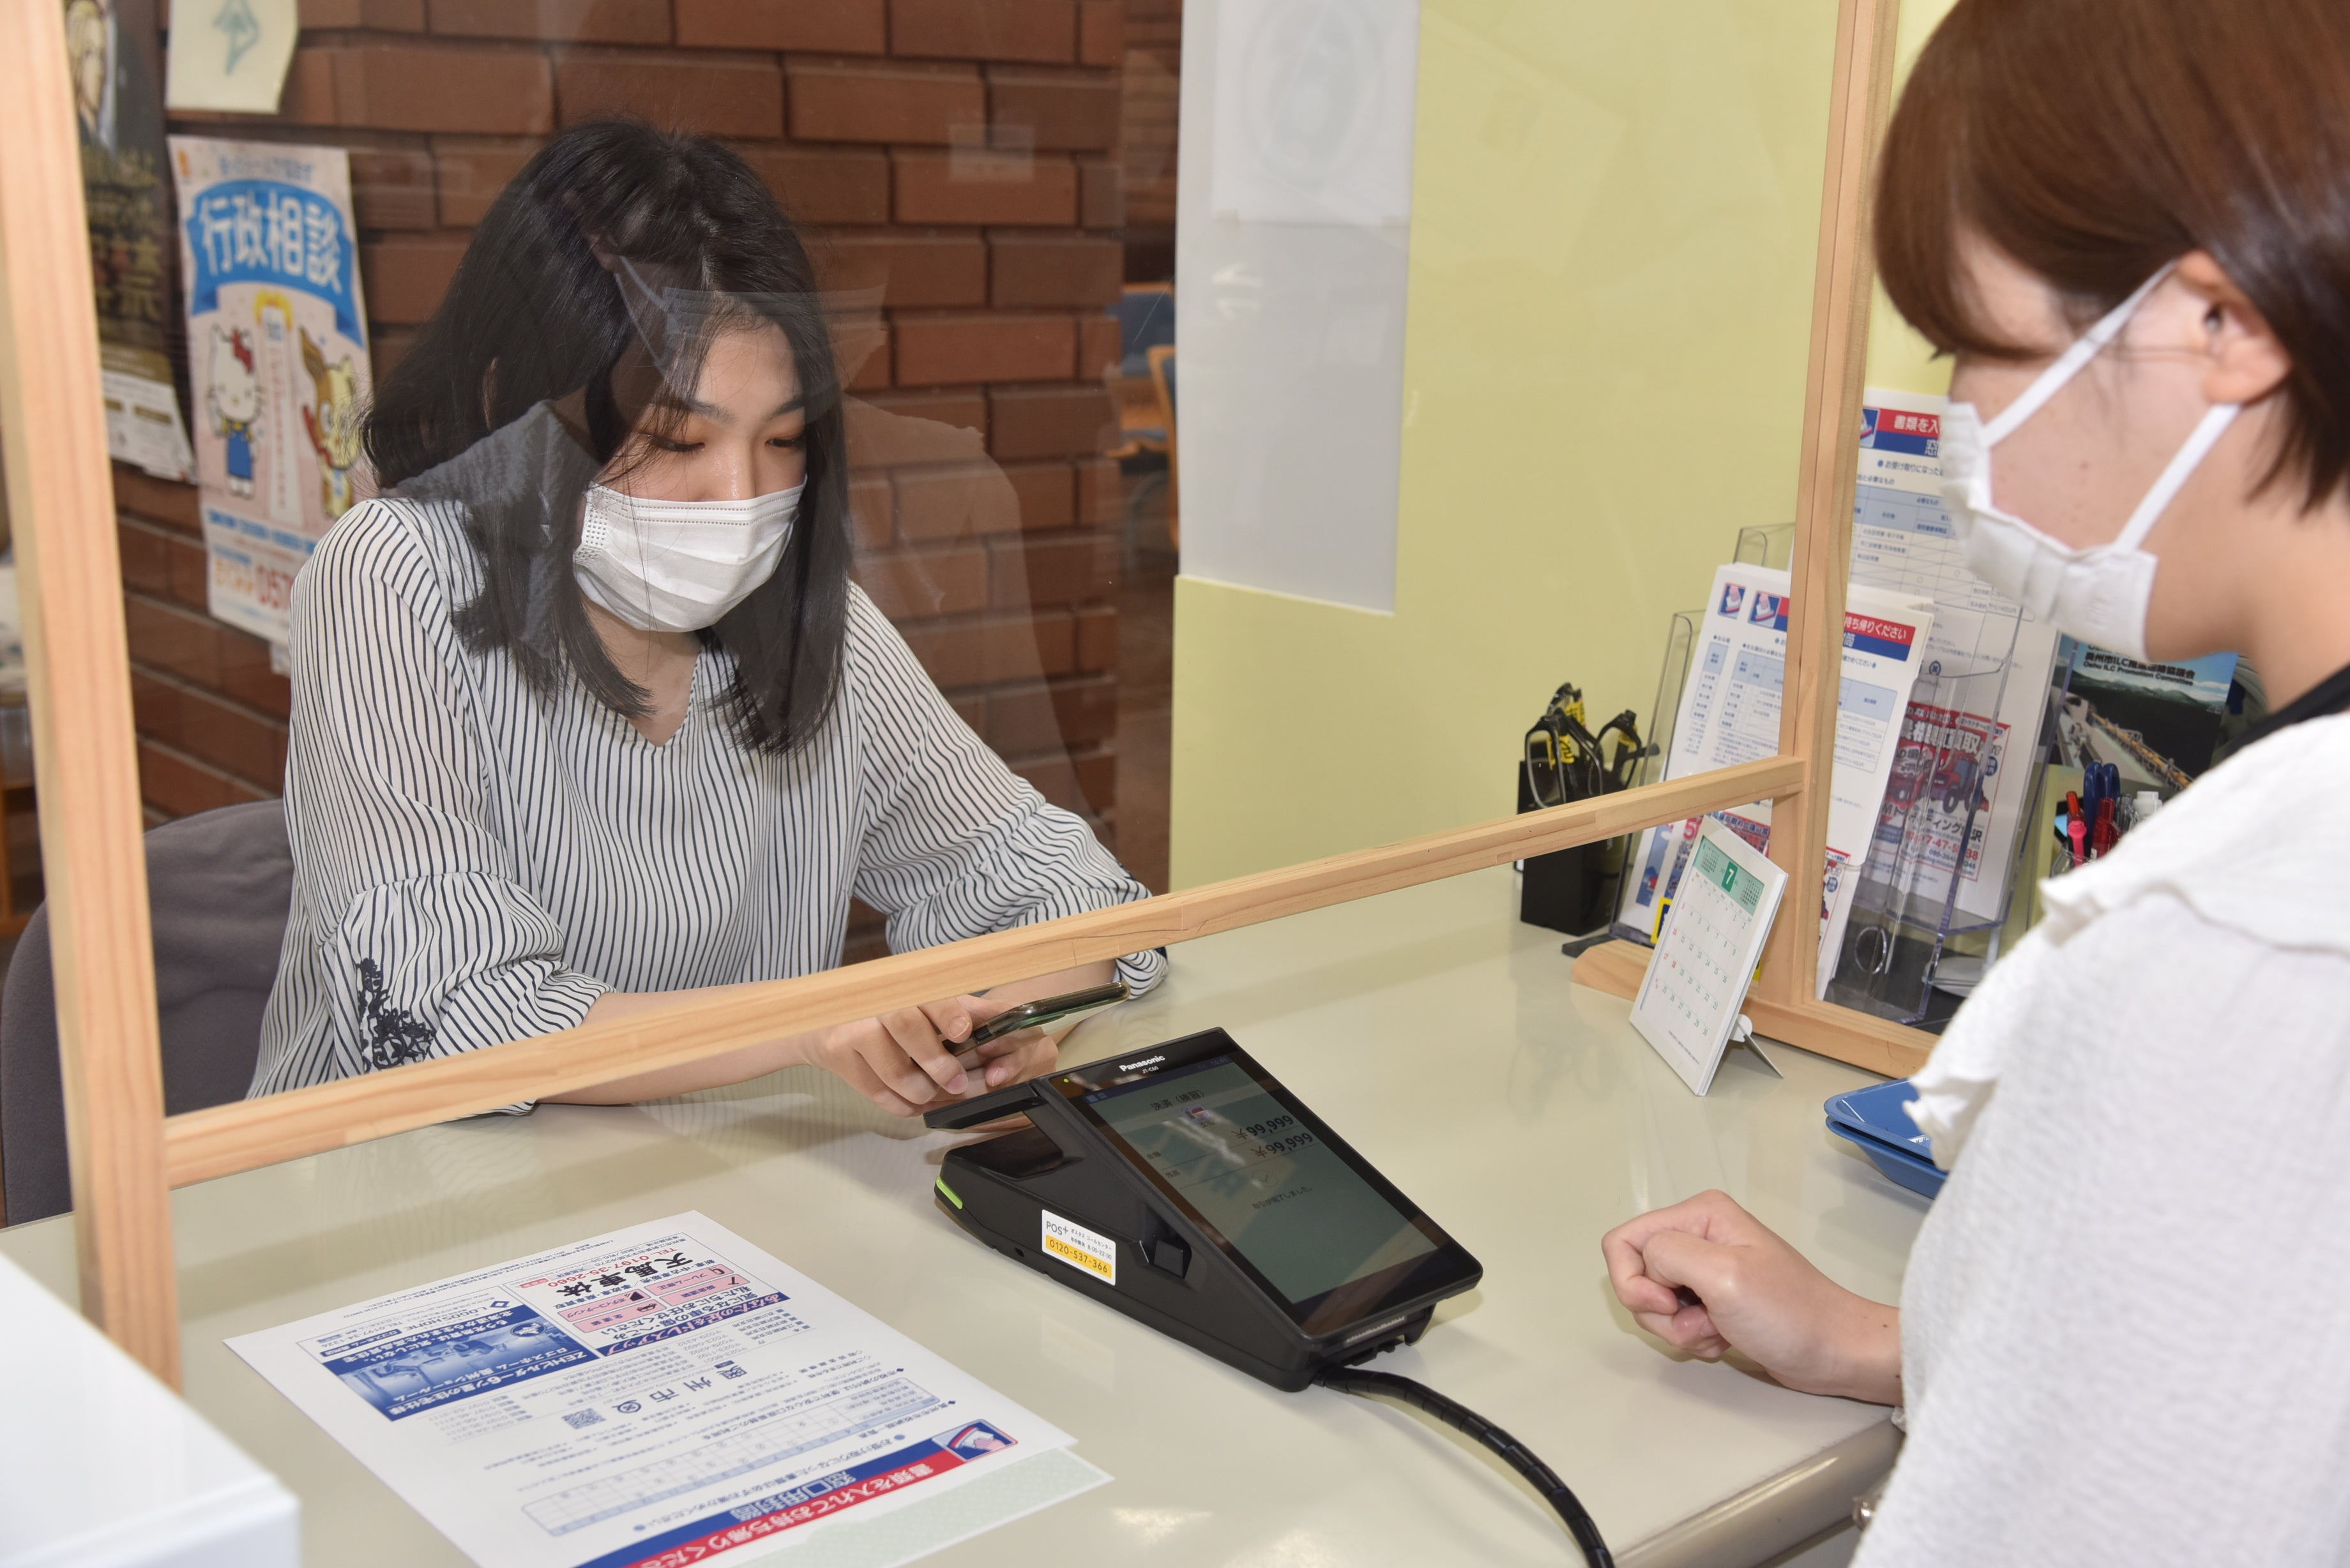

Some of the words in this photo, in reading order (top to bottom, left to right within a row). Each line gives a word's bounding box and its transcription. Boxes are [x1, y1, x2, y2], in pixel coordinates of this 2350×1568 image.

[199, 190, 342, 294] 行政相談
[2083, 661, 2102, 670] Oshu
[2118, 667, 2154, 679] Promotion
[2155, 672, 2194, 686] Committee
[1725, 868, 1734, 884] 7
[1119, 1055, 1166, 1073] Panasonic
[1142, 1066, 1160, 1074] JT-C60
[1046, 1220, 1069, 1236] POS+
[1071, 1228, 1085, 1238] ポスタス
[1086, 1235, 1112, 1250] コールセンター
[1049, 1239, 1108, 1274] 0120-537-366
[1070, 1237, 1086, 1248] 年中無休
[1087, 1244, 1112, 1260] 8:00-22:00
[546, 1255, 650, 1287] 0197-35-2660
[552, 1251, 696, 1299] 天馬車体
[655, 1272, 708, 1290] フレーム修正
[564, 1297, 626, 1318] ボディコーティング
[599, 1285, 752, 1336] 私たちにお任せください
[599, 1293, 785, 1355] あなたの足をドレスアップ
[610, 1292, 758, 1341] 気になる車の傷・へこみ
[341, 1310, 514, 1362] 北海道から生まれた高品質住宅
[494, 1347, 568, 1371] ロゴスホーム
[386, 1351, 588, 1415] ZEHビルダー6ツ星の住宅仕様
[391, 1368, 495, 1402] 奥州ショールーム
[646, 1365, 750, 1403] 奥州市
[726, 1470, 859, 1522] 窓口用封筒
